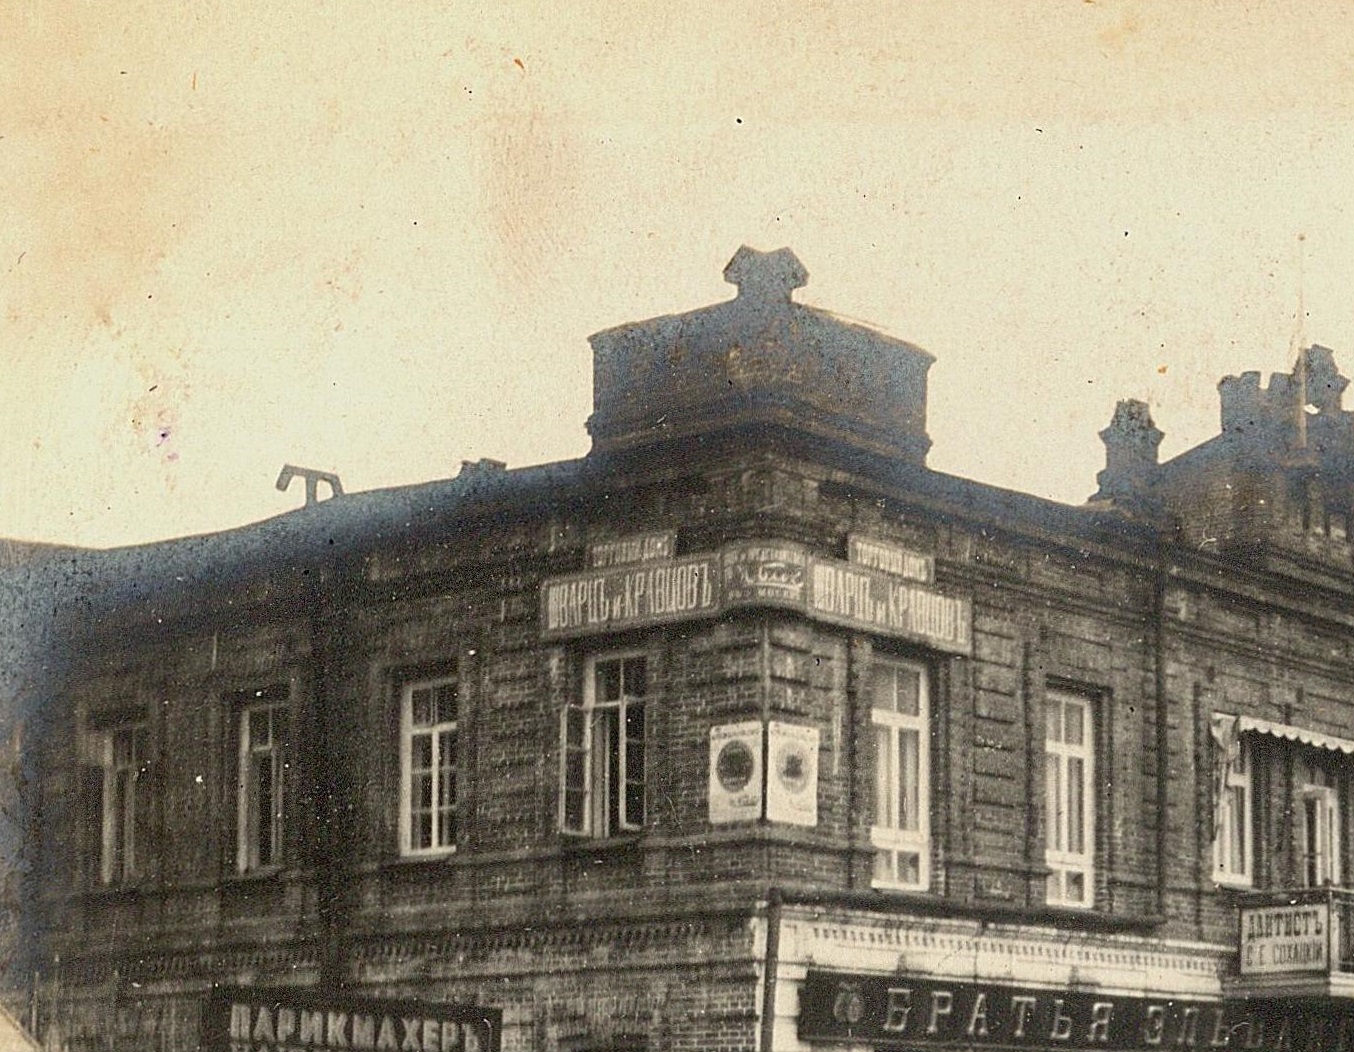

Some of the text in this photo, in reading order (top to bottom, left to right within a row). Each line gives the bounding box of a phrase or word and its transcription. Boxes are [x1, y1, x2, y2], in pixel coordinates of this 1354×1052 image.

[548, 578, 609, 630] ШВАРЦЪ
[624, 560, 713, 617] КРАВЦОВЪ
[888, 581, 966, 644] КРАВЦОВЪ
[1247, 909, 1323, 942] ДАНТИСТЪ
[882, 986, 1114, 1042] БРАТЬЯ
